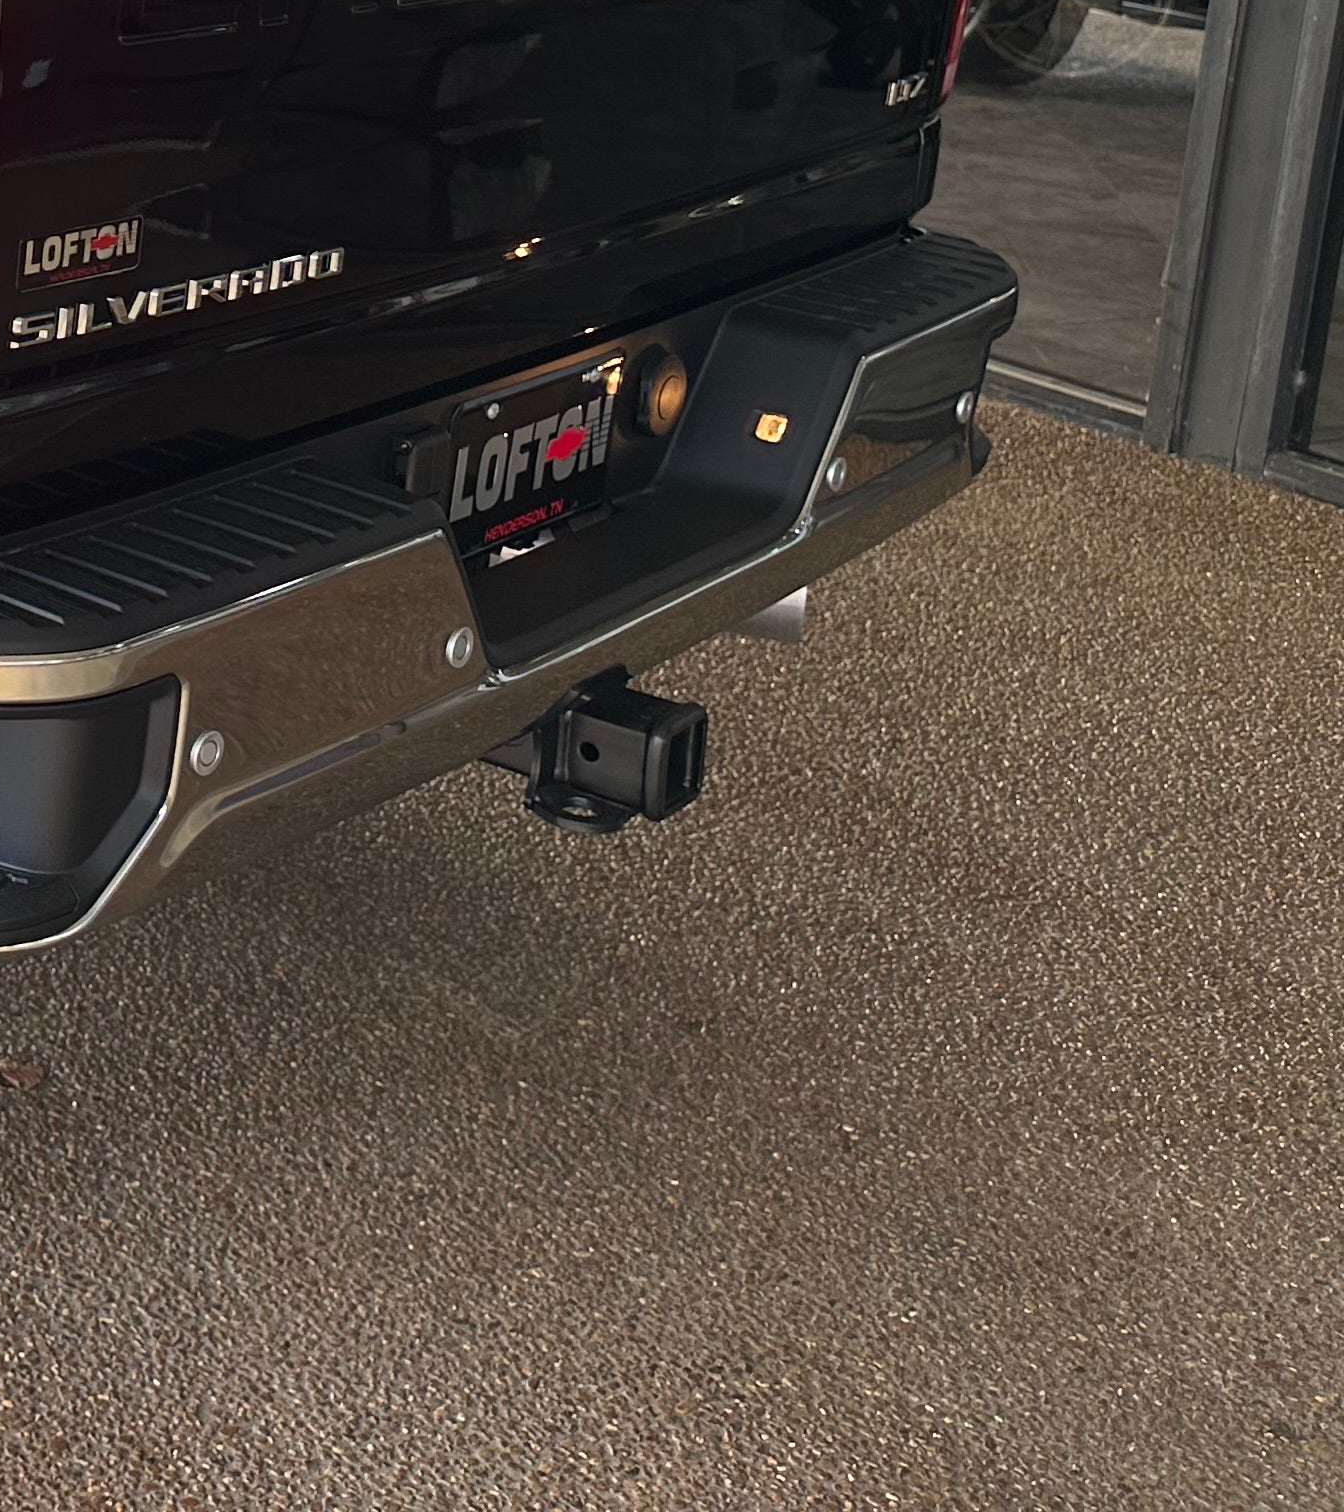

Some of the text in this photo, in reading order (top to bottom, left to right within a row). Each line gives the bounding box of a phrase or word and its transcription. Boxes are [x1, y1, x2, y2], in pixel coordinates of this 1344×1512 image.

[9, 246, 345, 350] SILVERADO
[23, 219, 139, 276] LOFTON
[449, 395, 614, 523] LOFTON
